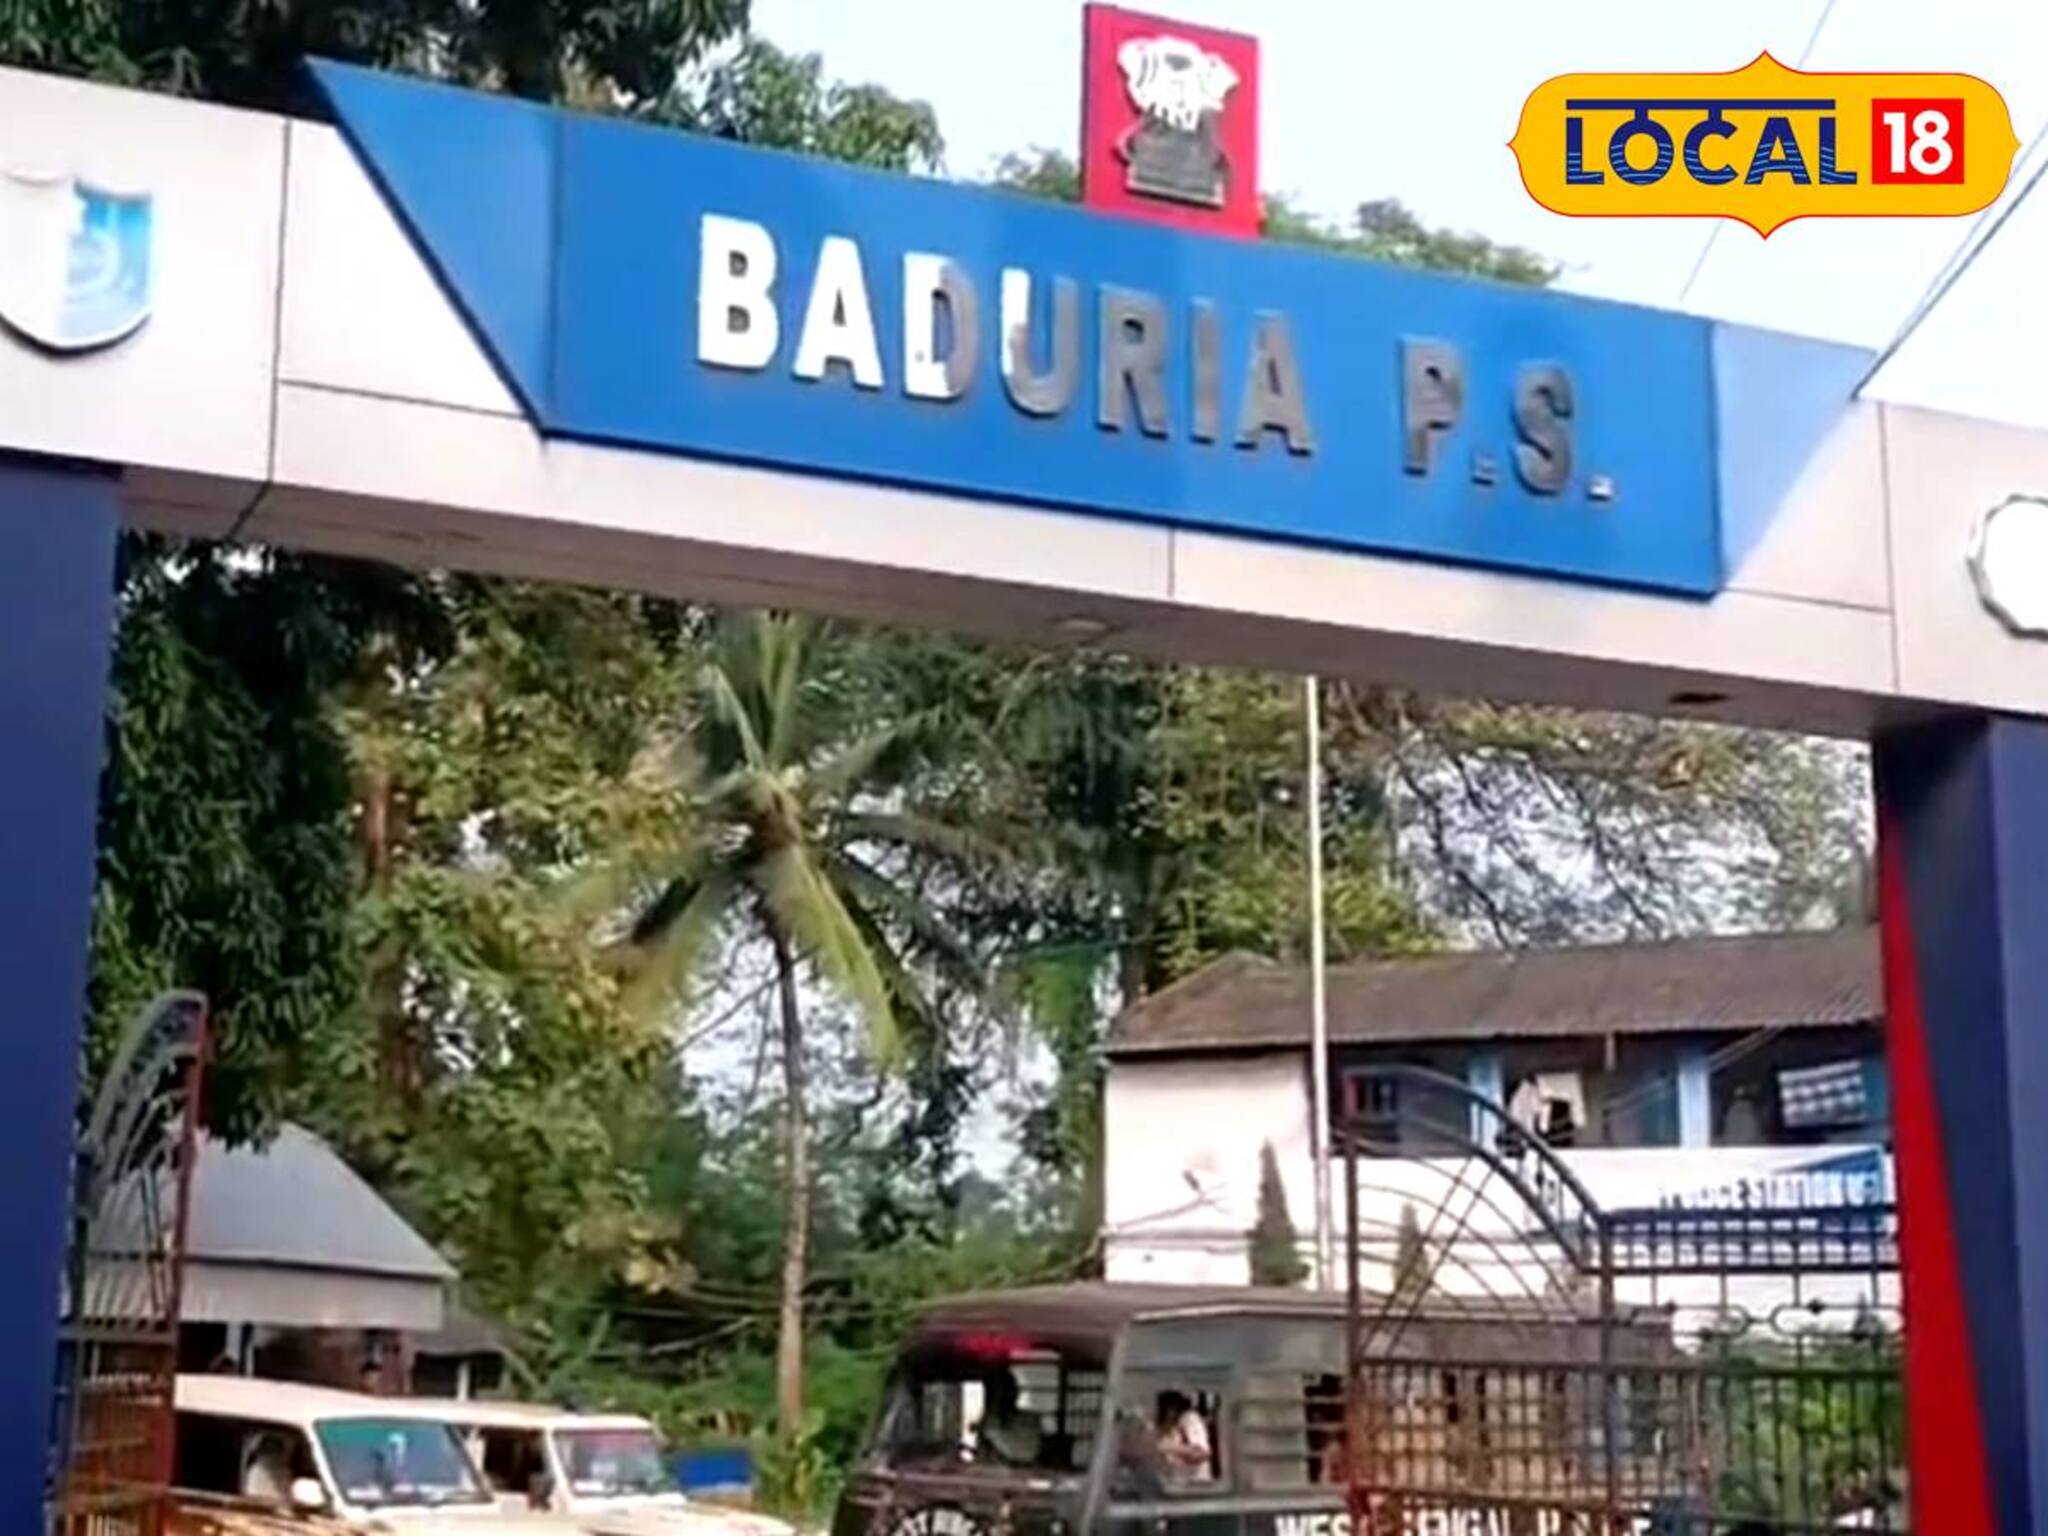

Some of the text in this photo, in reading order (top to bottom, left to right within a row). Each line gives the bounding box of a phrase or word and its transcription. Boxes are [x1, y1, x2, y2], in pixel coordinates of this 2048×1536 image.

[697, 213, 1615, 502] BADURIA P.S.
[1275, 1511, 1370, 1536] WES
